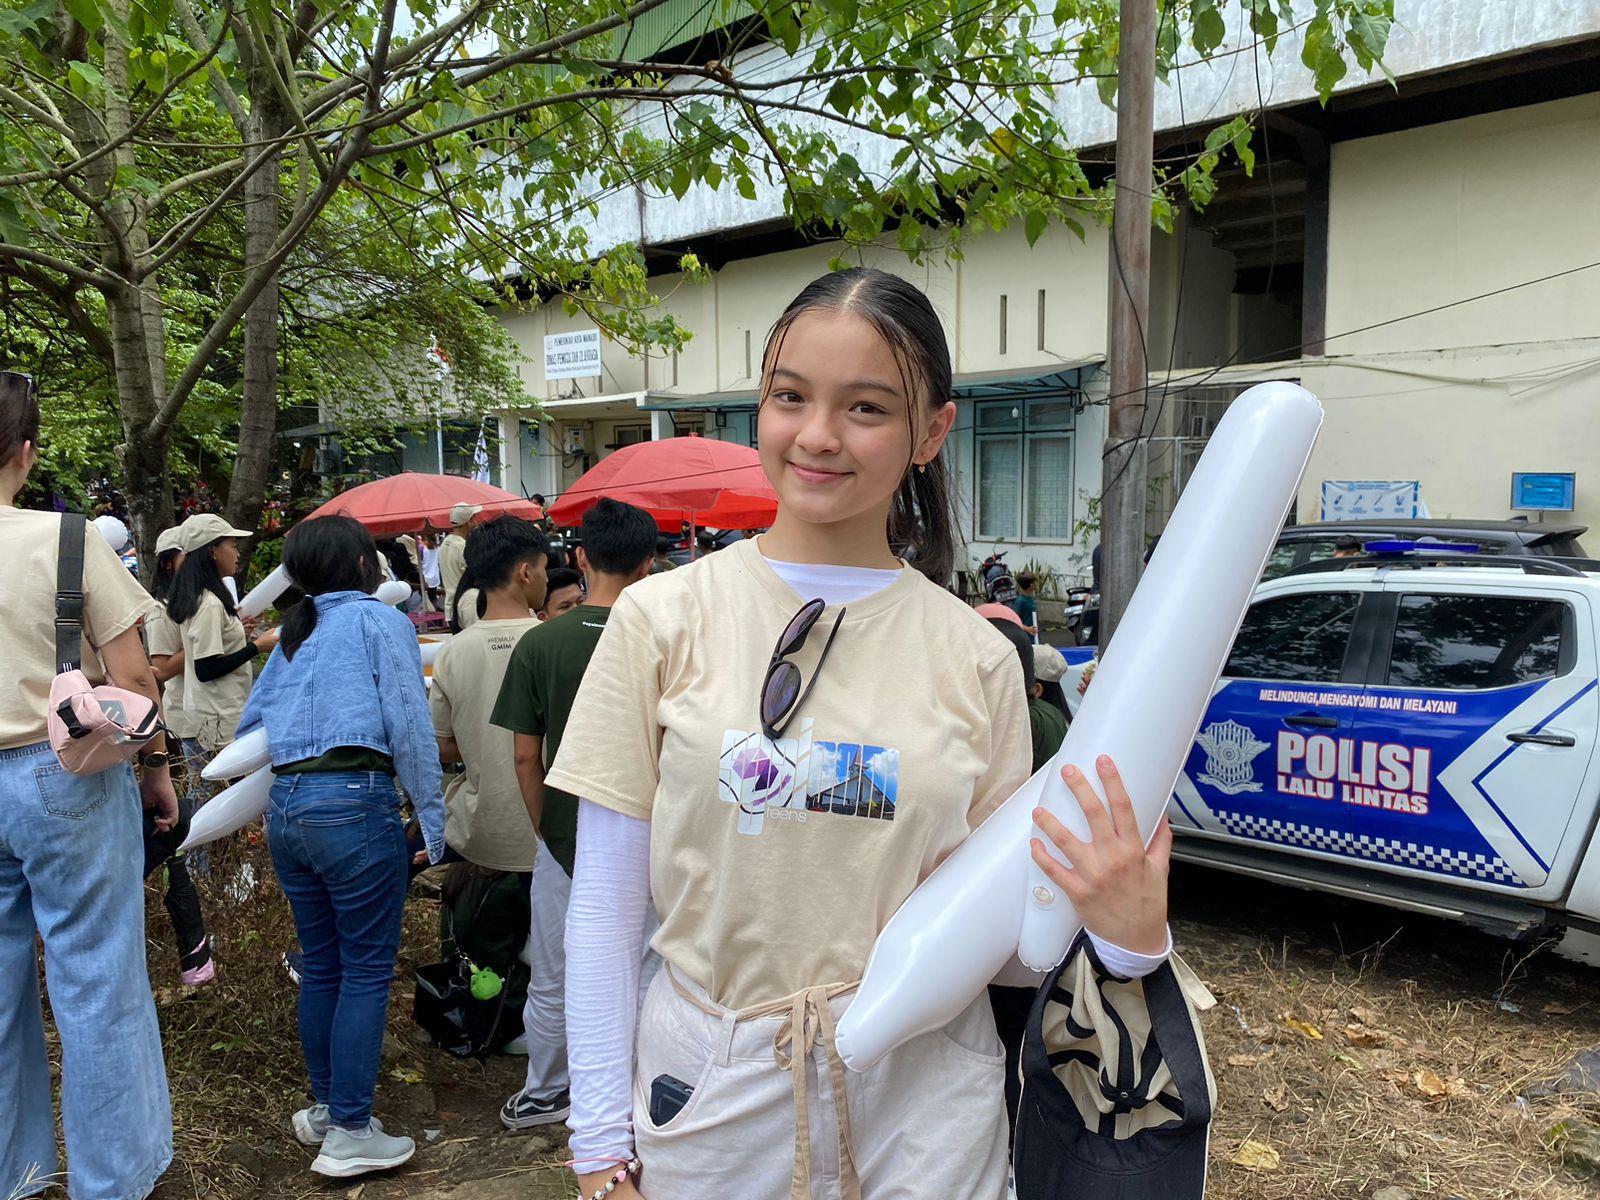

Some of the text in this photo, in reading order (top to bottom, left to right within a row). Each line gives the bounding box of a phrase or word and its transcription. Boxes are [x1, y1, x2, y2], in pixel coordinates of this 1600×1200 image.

[1379, 697, 1401, 710] DAN
[1403, 698, 1458, 715] MELAYANI
[1277, 730, 1431, 794] POLISI
[1277, 774, 1335, 800] LALU
[1342, 784, 1430, 816] LINTAS
[766, 806, 807, 823] teens
